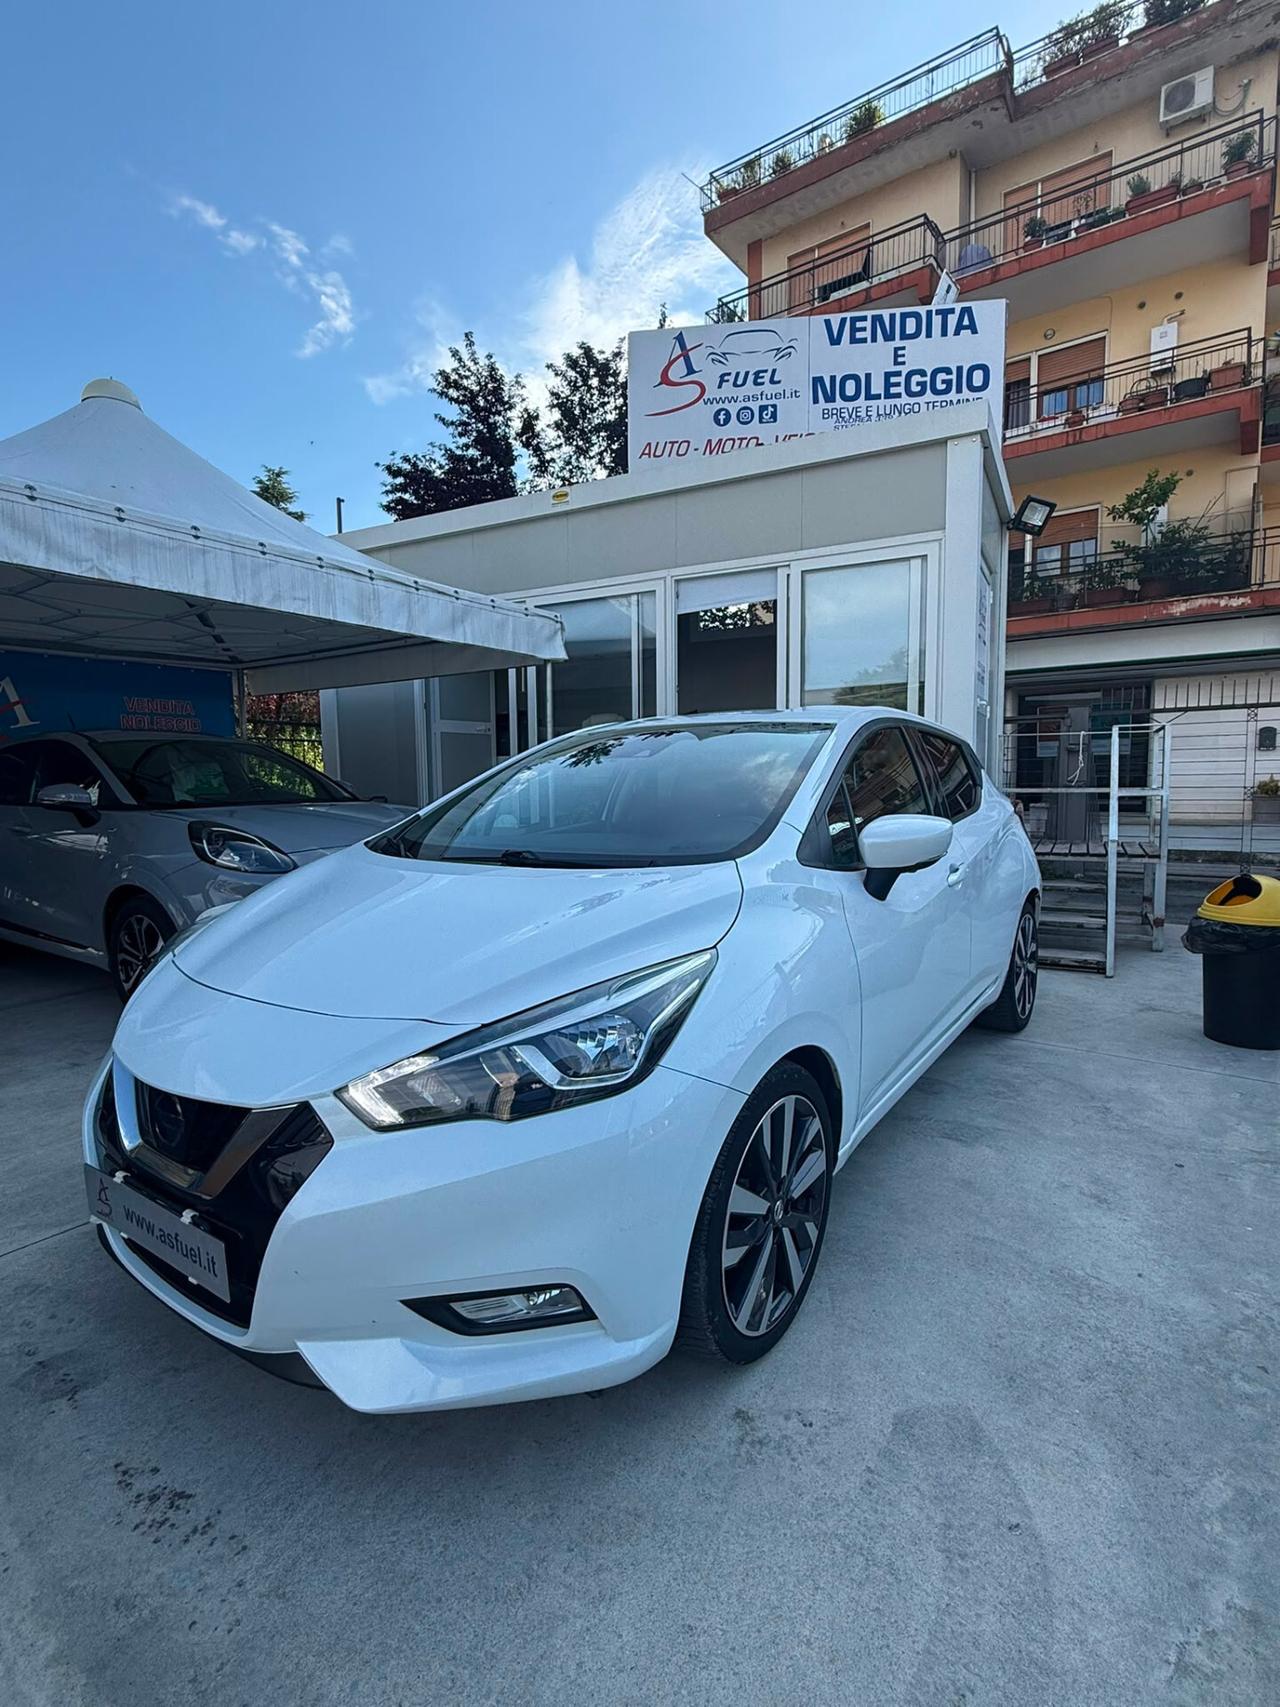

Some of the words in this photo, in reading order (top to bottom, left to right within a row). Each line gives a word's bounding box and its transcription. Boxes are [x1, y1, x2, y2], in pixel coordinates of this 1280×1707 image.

[823, 306, 979, 346] VENDITA
[893, 346, 906, 367] E
[716, 368, 782, 390] FUEL
[811, 363, 991, 405] NOLEGGIO
[703, 389, 801, 405] www.asfuel.it
[821, 406, 863, 420] BREVE
[865, 405, 873, 417] E
[875, 401, 921, 417] LUNGO
[924, 397, 983, 412] TERM
[639, 440, 691, 459] AUTO
[702, 436, 761, 456] MOTO
[0, 676, 40, 732] A
[123, 697, 195, 715] VENDITA
[120, 714, 201, 731] NOLEGGIO
[123, 1206, 218, 1278] www.asfuel.it
